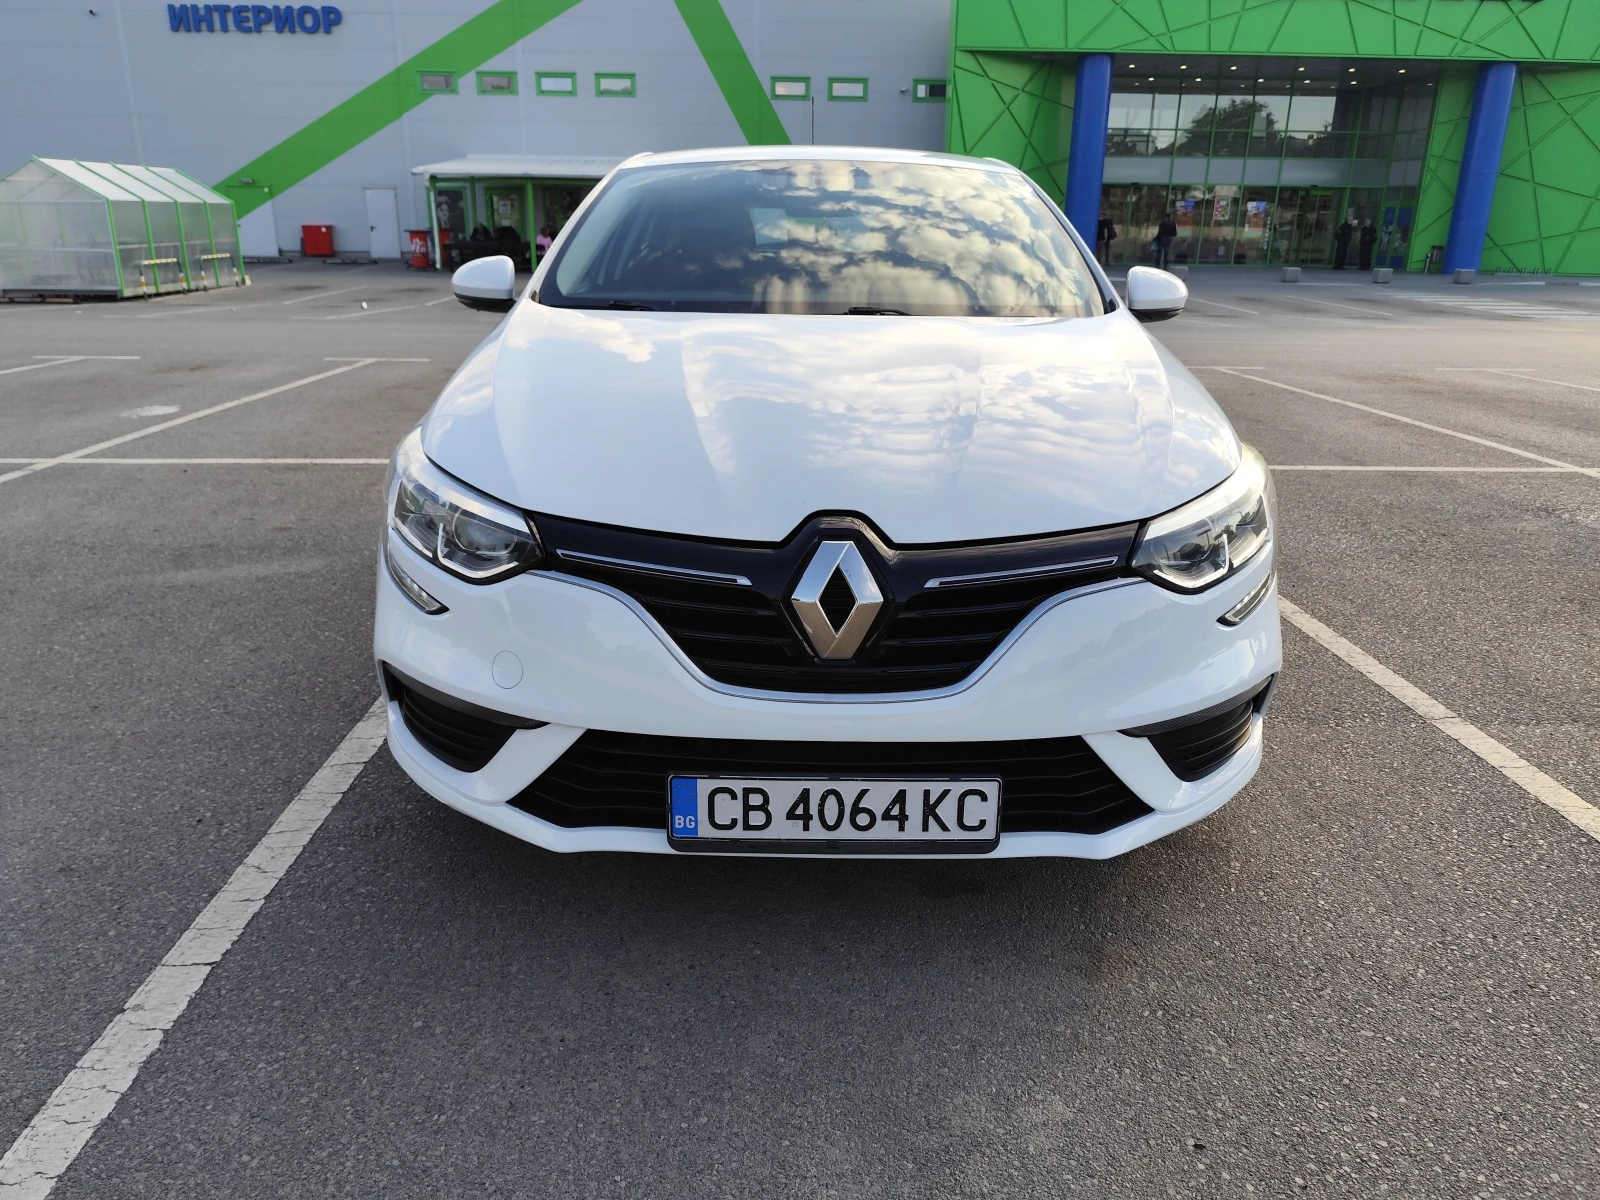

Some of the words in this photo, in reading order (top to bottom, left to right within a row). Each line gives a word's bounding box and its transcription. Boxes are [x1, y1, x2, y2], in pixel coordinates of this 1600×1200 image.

[167, 3, 342, 35] ИНТЕРИОР
[674, 815, 696, 829] BG
[707, 786, 773, 831] CB
[785, 787, 909, 832] 4064
[921, 788, 989, 832] KC
